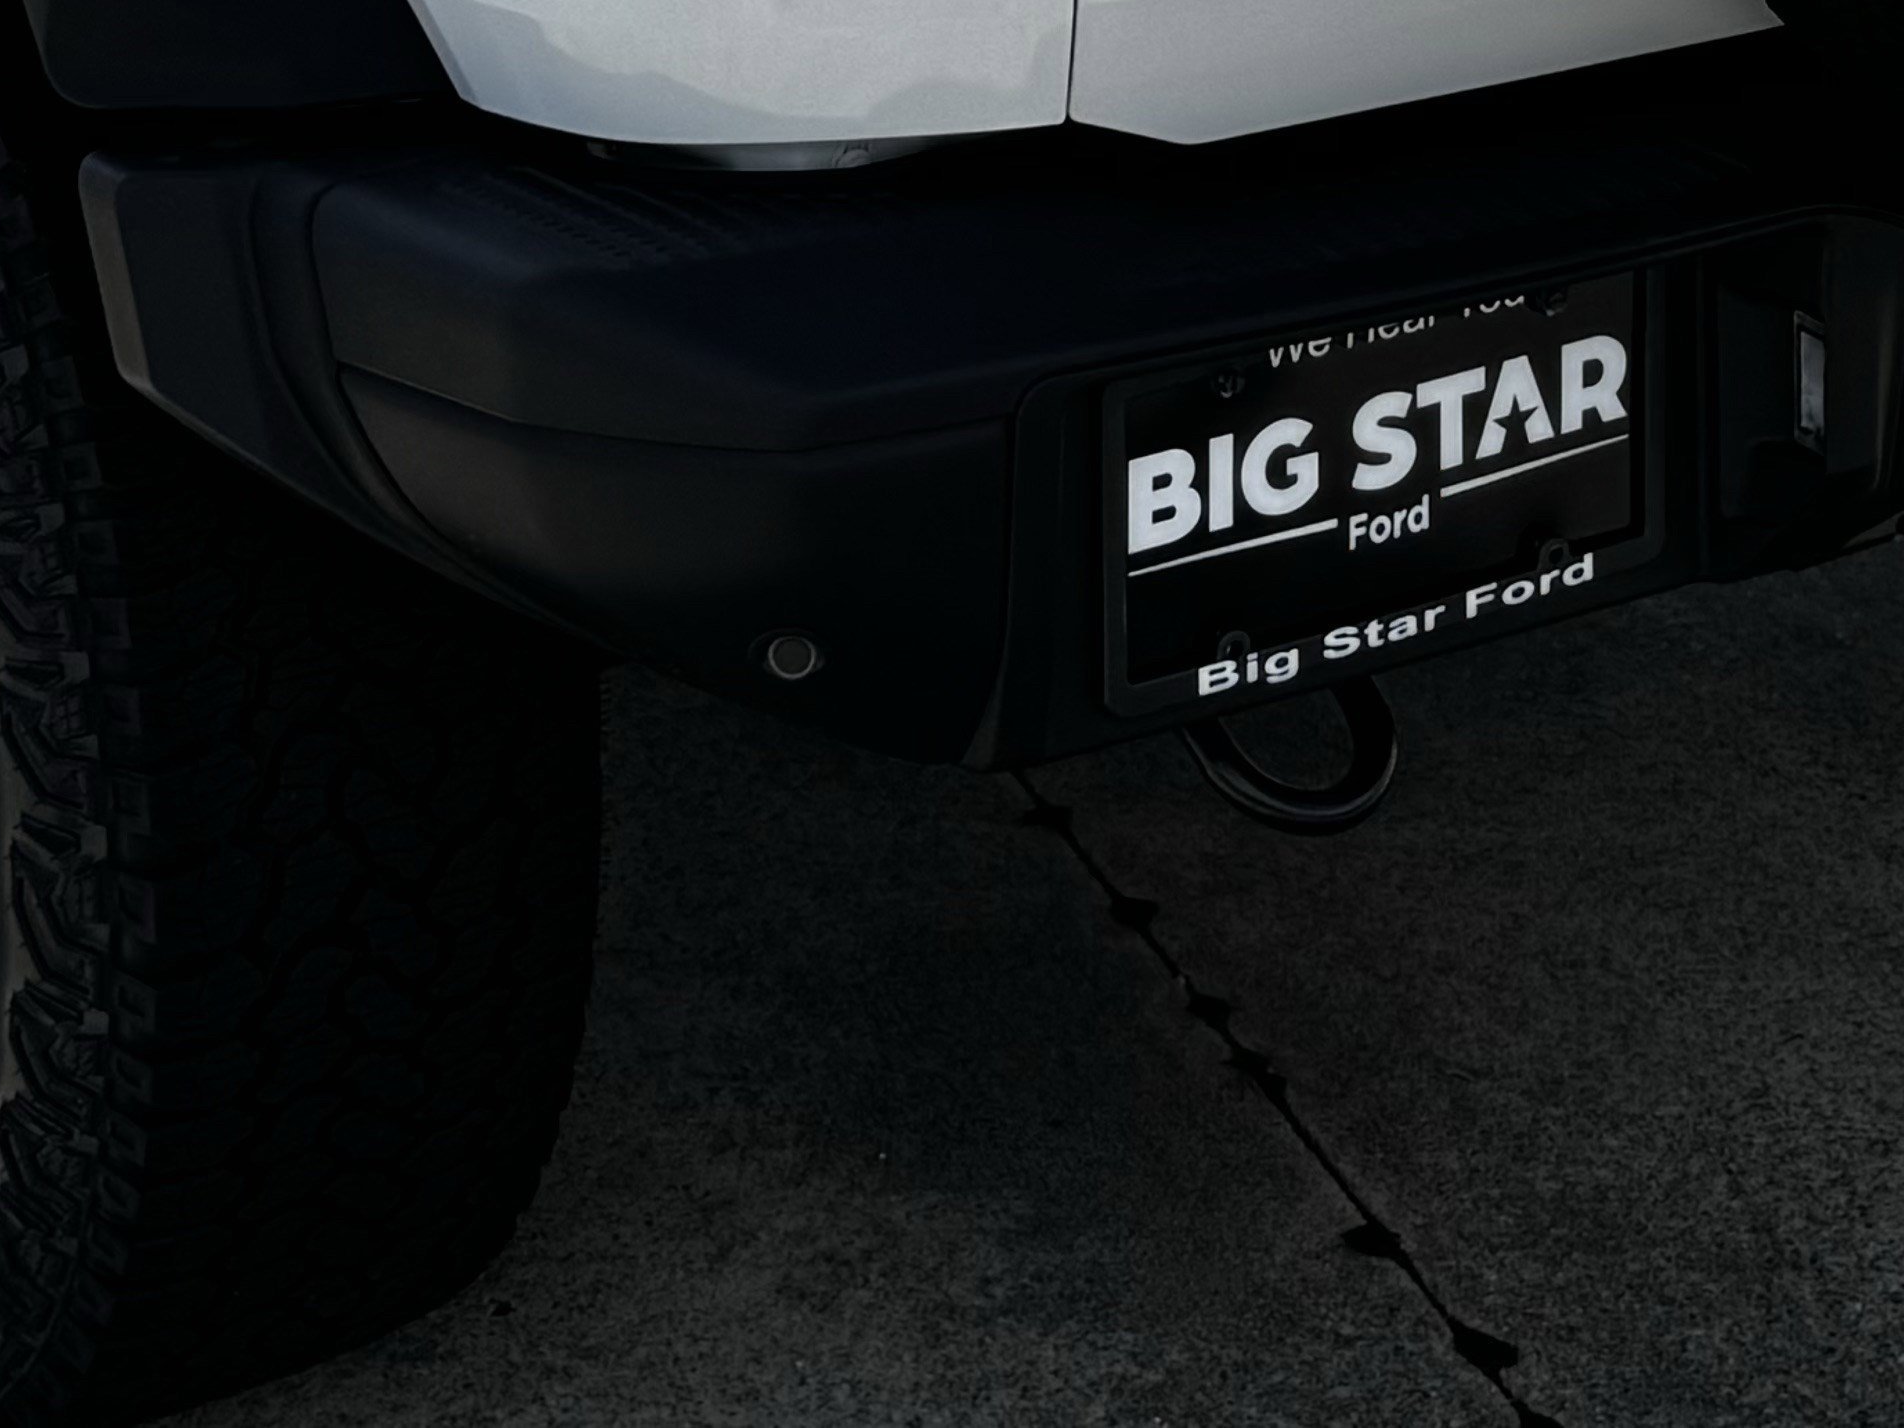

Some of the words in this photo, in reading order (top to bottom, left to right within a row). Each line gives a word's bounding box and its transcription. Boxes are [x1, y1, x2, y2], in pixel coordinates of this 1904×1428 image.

[1128, 417, 1321, 555] BIG
[1351, 335, 1630, 492] STAR
[1348, 494, 1431, 551] Ford
[1198, 647, 1301, 696] Big
[1323, 604, 1447, 660] Star
[1465, 552, 1595, 620] Ford
